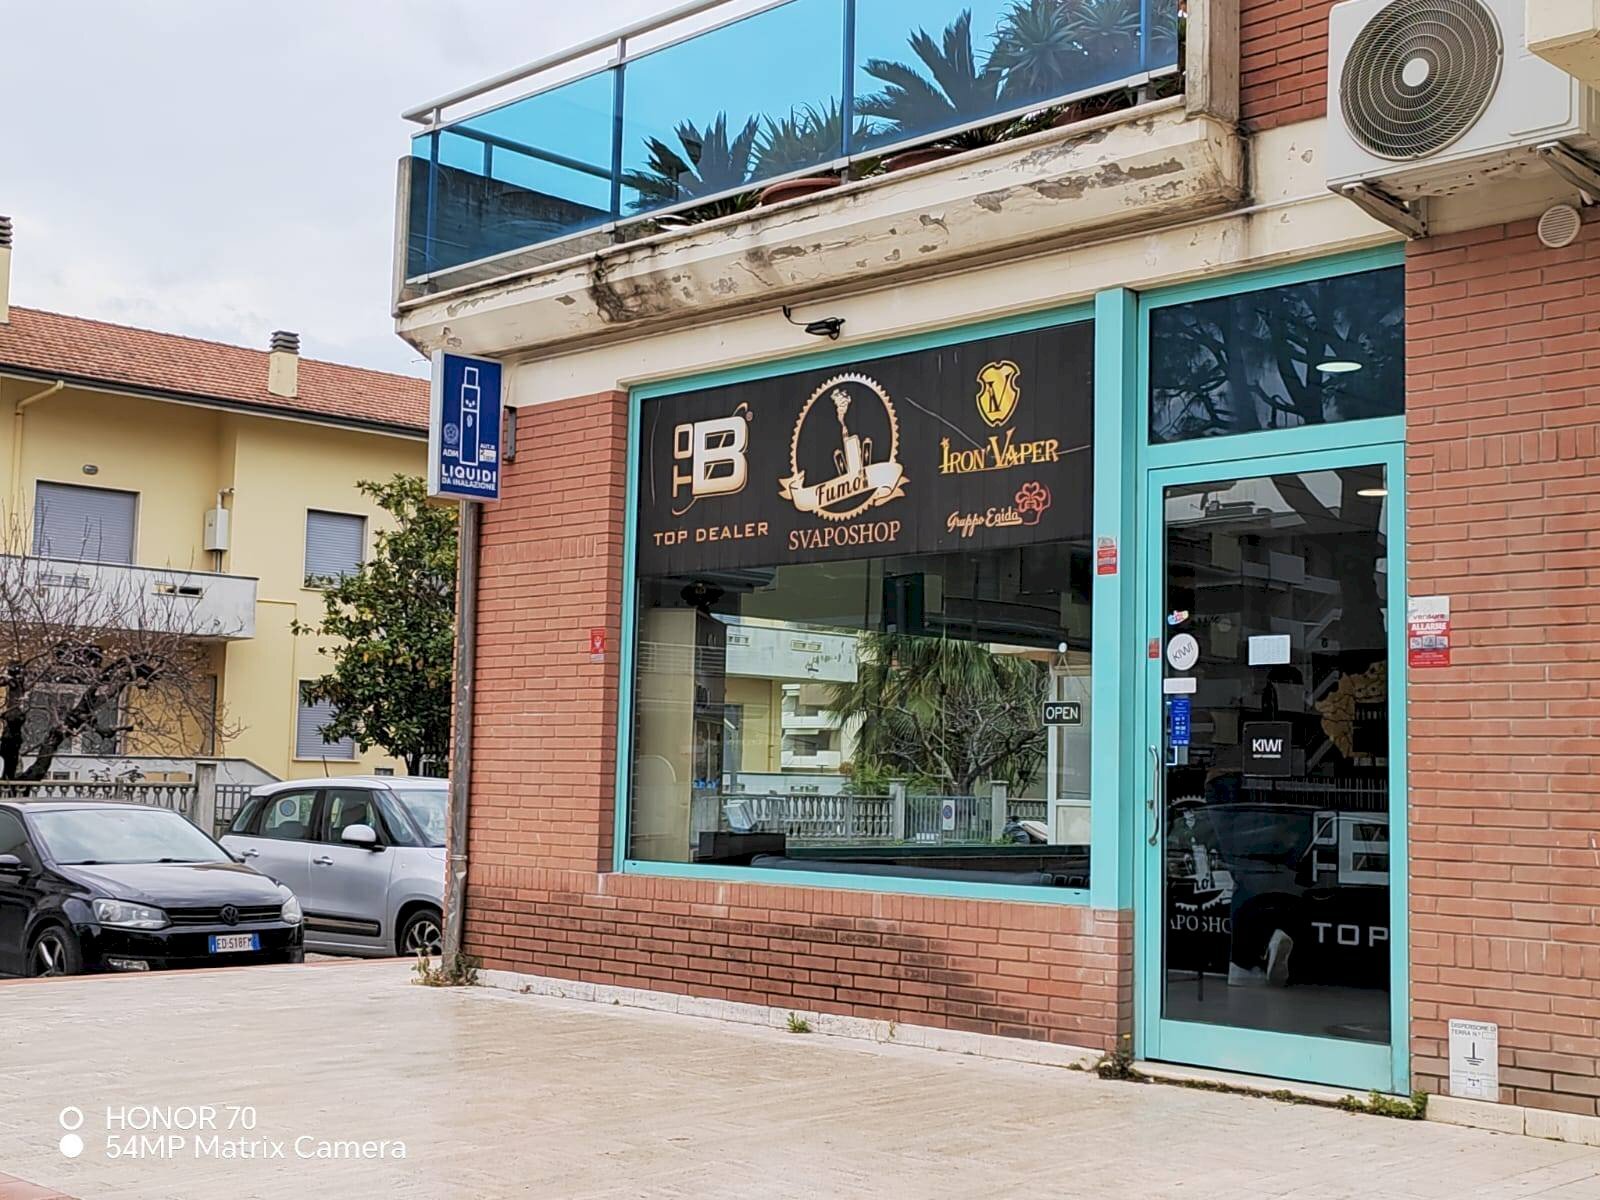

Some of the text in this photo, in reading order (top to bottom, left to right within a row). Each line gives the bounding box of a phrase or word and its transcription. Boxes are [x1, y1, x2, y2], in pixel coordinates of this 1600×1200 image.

[988, 427, 1060, 467] VAPER
[442, 464, 496, 483] LIQUIDI
[453, 479, 496, 490] INALAZIONE
[653, 521, 769, 547] TOP DEALER
[788, 520, 901, 551] SVAPOSHOP
[946, 511, 985, 538] Gruppo
[1045, 706, 1079, 720] OPEN
[1252, 738, 1284, 753] KIWI
[1311, 922, 1389, 947] TOP
